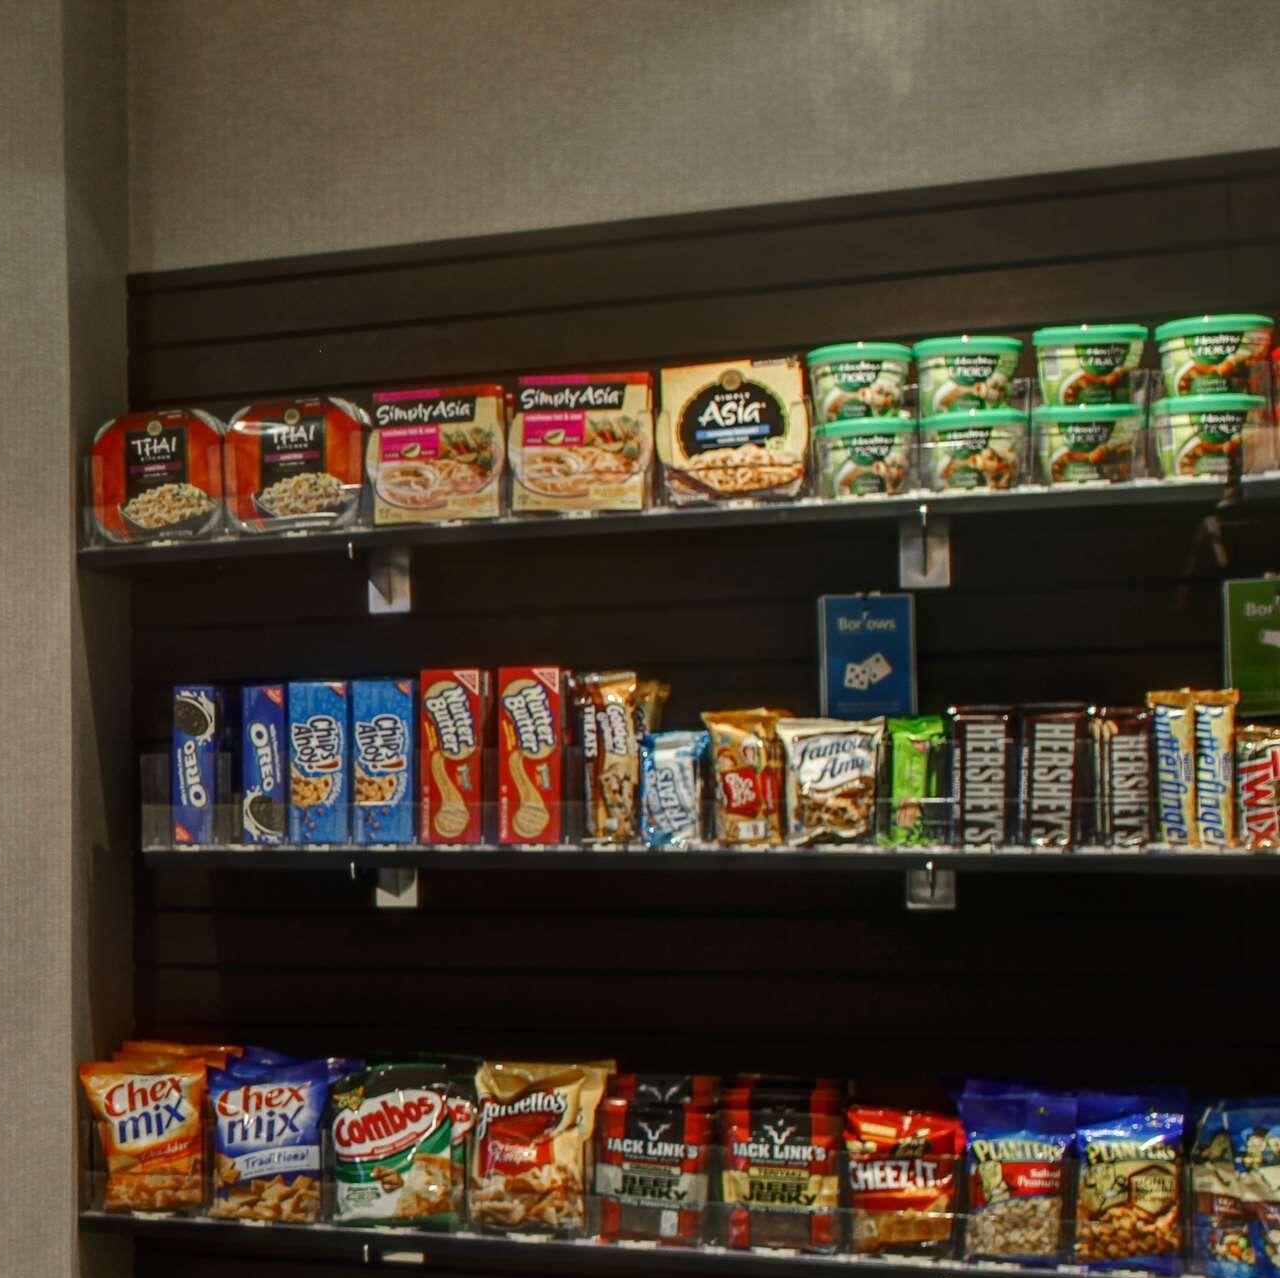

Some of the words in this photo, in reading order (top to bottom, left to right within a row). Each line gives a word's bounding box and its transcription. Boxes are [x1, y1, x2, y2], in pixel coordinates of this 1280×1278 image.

[272, 425, 316, 444] THAI
[698, 400, 761, 426] Asia
[131, 436, 177, 456] THAI
[838, 617, 897, 631] Borows
[308, 715, 338, 763] Chips
[372, 714, 401, 762] Chips
[426, 696, 461, 755] Butter
[442, 686, 474, 747] Nutter
[504, 695, 540, 755] Butter
[521, 685, 556, 745] Nutter
[583, 705, 598, 757] TREATS
[183, 740, 208, 808] OREO
[249, 721, 274, 792] OREO
[1155, 705, 1189, 845] Butterfinge
[655, 767, 689, 828] TREATS
[964, 723, 1006, 849] HERSHEY'S
[1031, 723, 1076, 847] HERSHEY'S
[1240, 750, 1280, 848] TWIX
[104, 1076, 185, 1118] Chex
[118, 1095, 187, 1144] mix
[216, 1080, 312, 1118] Chex
[226, 1105, 305, 1145] mix
[335, 1095, 435, 1148] Combos
[243, 1149, 311, 1169] Traditional
[608, 1138, 644, 1154] JACK
[648, 1141, 698, 1159] LINK'S
[733, 1142, 770, 1158] JACK
[774, 1144, 826, 1162] LINK'S
[973, 1139, 1067, 1162] PLANTERS
[614, 1186, 688, 1201] JERKY
[742, 1191, 818, 1206] JERKY
